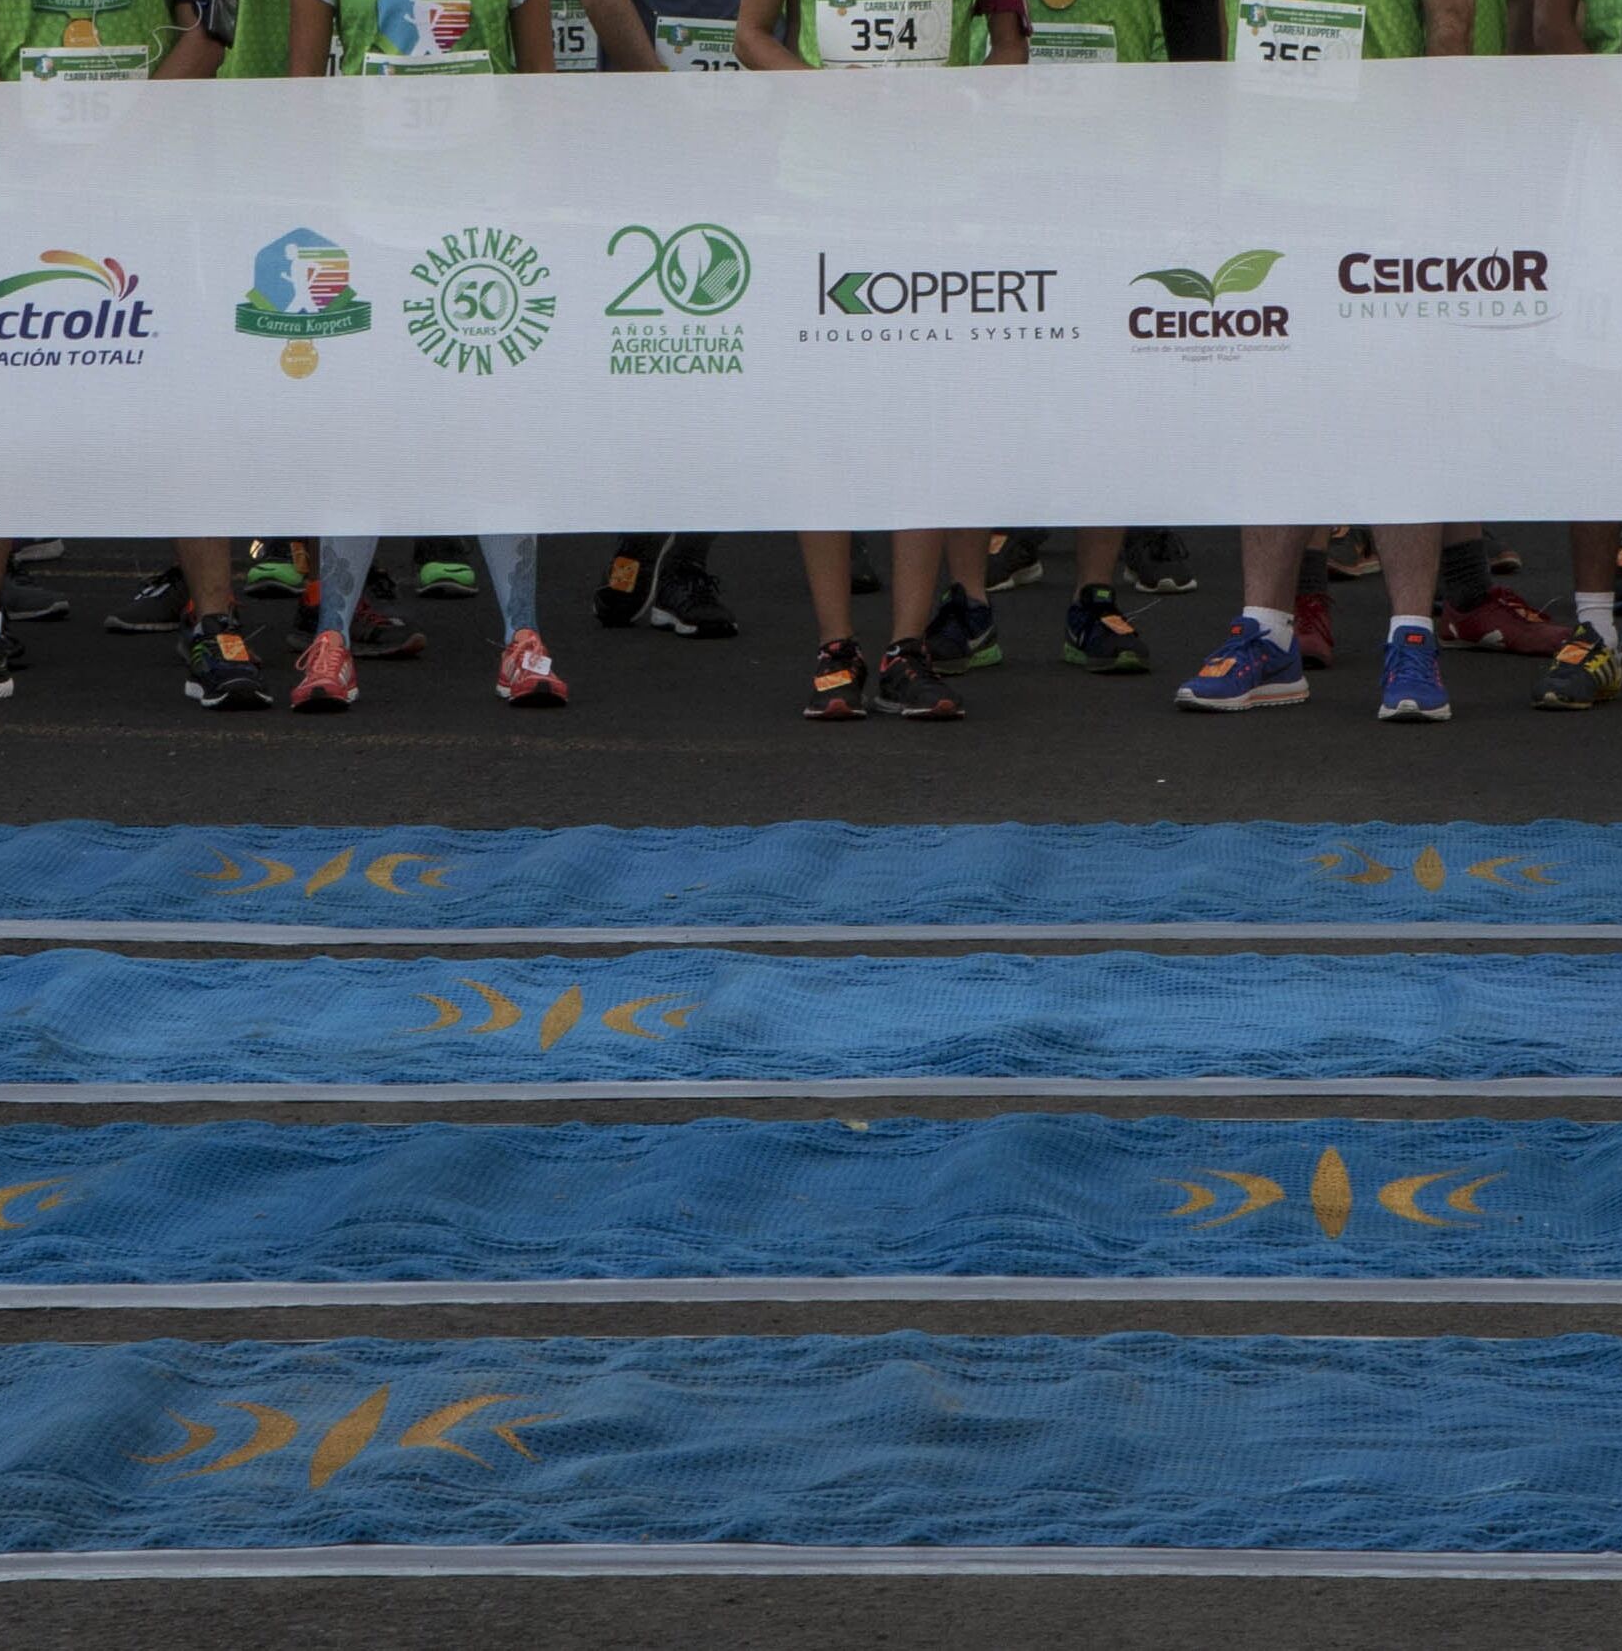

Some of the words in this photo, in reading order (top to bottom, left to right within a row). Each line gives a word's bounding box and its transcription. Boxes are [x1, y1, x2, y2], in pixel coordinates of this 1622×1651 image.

[863, 0, 899, 12] CARRERA
[552, 25, 585, 53] 15
[850, 17, 918, 52] 354
[410, 226, 551, 288] PARTNERS
[1338, 250, 1548, 294] CEICKOR
[452, 280, 509, 322] 50
[1338, 300, 1550, 320] UNIVERSIDAD
[256, 316, 302, 334] Carrera
[304, 313, 353, 335] Koppert
[461, 325, 498, 338] YEARS
[508, 294, 557, 367] WITH
[611, 323, 668, 337] AÑOS
[682, 324, 708, 337] EN
[721, 323, 745, 337] LA
[1129, 302, 1289, 339] CEICKOR
[402, 295, 495, 377] NATURE
[611, 337, 744, 354] AGRICULTURA
[799, 328, 953, 342] BIOLOGICAL
[971, 327, 1080, 340] SYSTEMS
[68, 350, 144, 365] TOTAL!
[610, 352, 743, 374] MEXICANA
